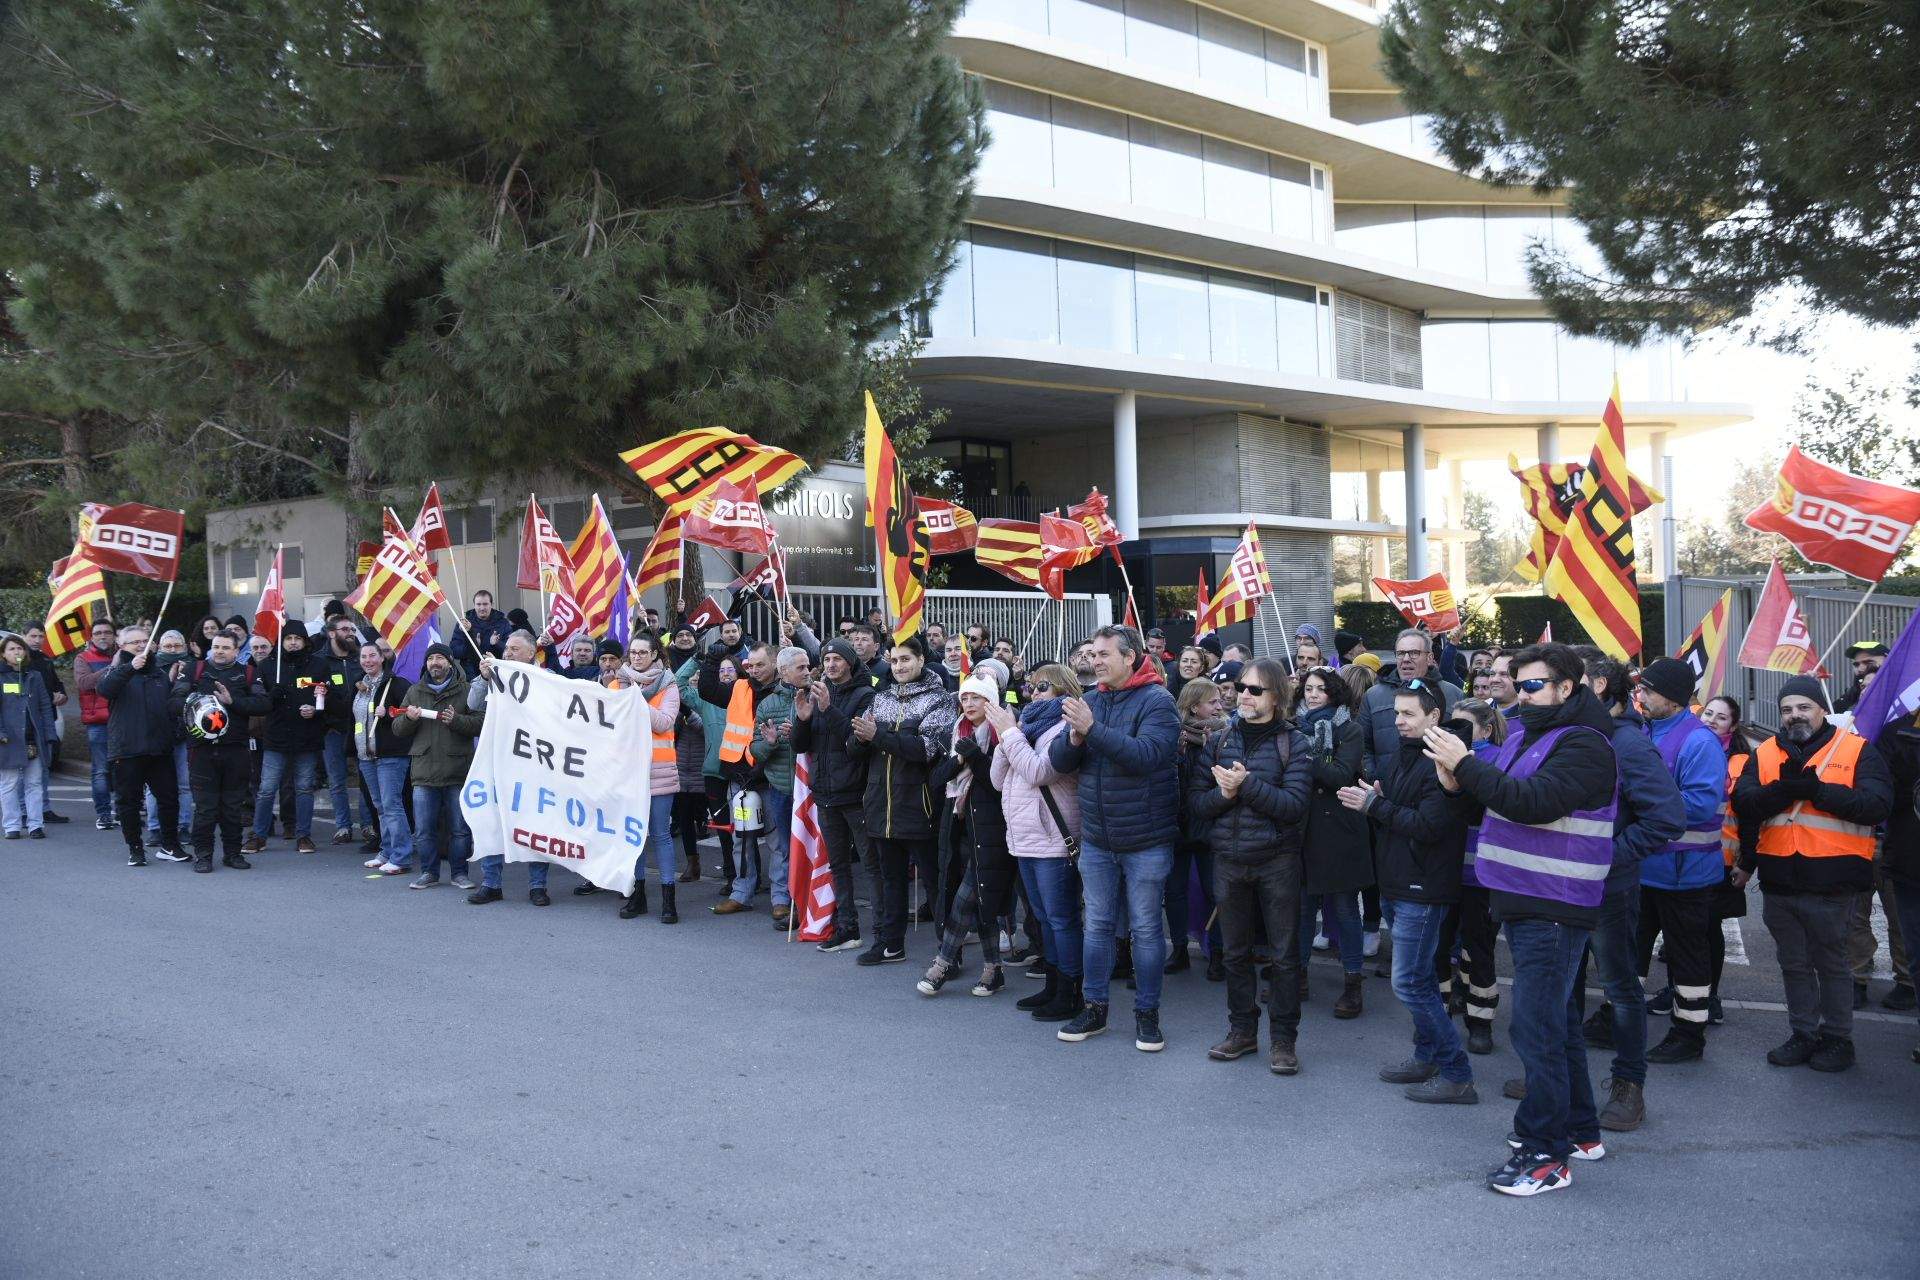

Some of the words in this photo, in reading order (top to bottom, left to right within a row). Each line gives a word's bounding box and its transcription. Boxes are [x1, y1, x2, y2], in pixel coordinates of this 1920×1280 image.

[772, 487, 853, 519] GRIFOLS
[488, 665, 530, 703] NO
[566, 694, 615, 730] AL
[513, 728, 587, 778] ERE
[463, 780, 643, 847] GIFOLS
[512, 828, 586, 860] CCOO
